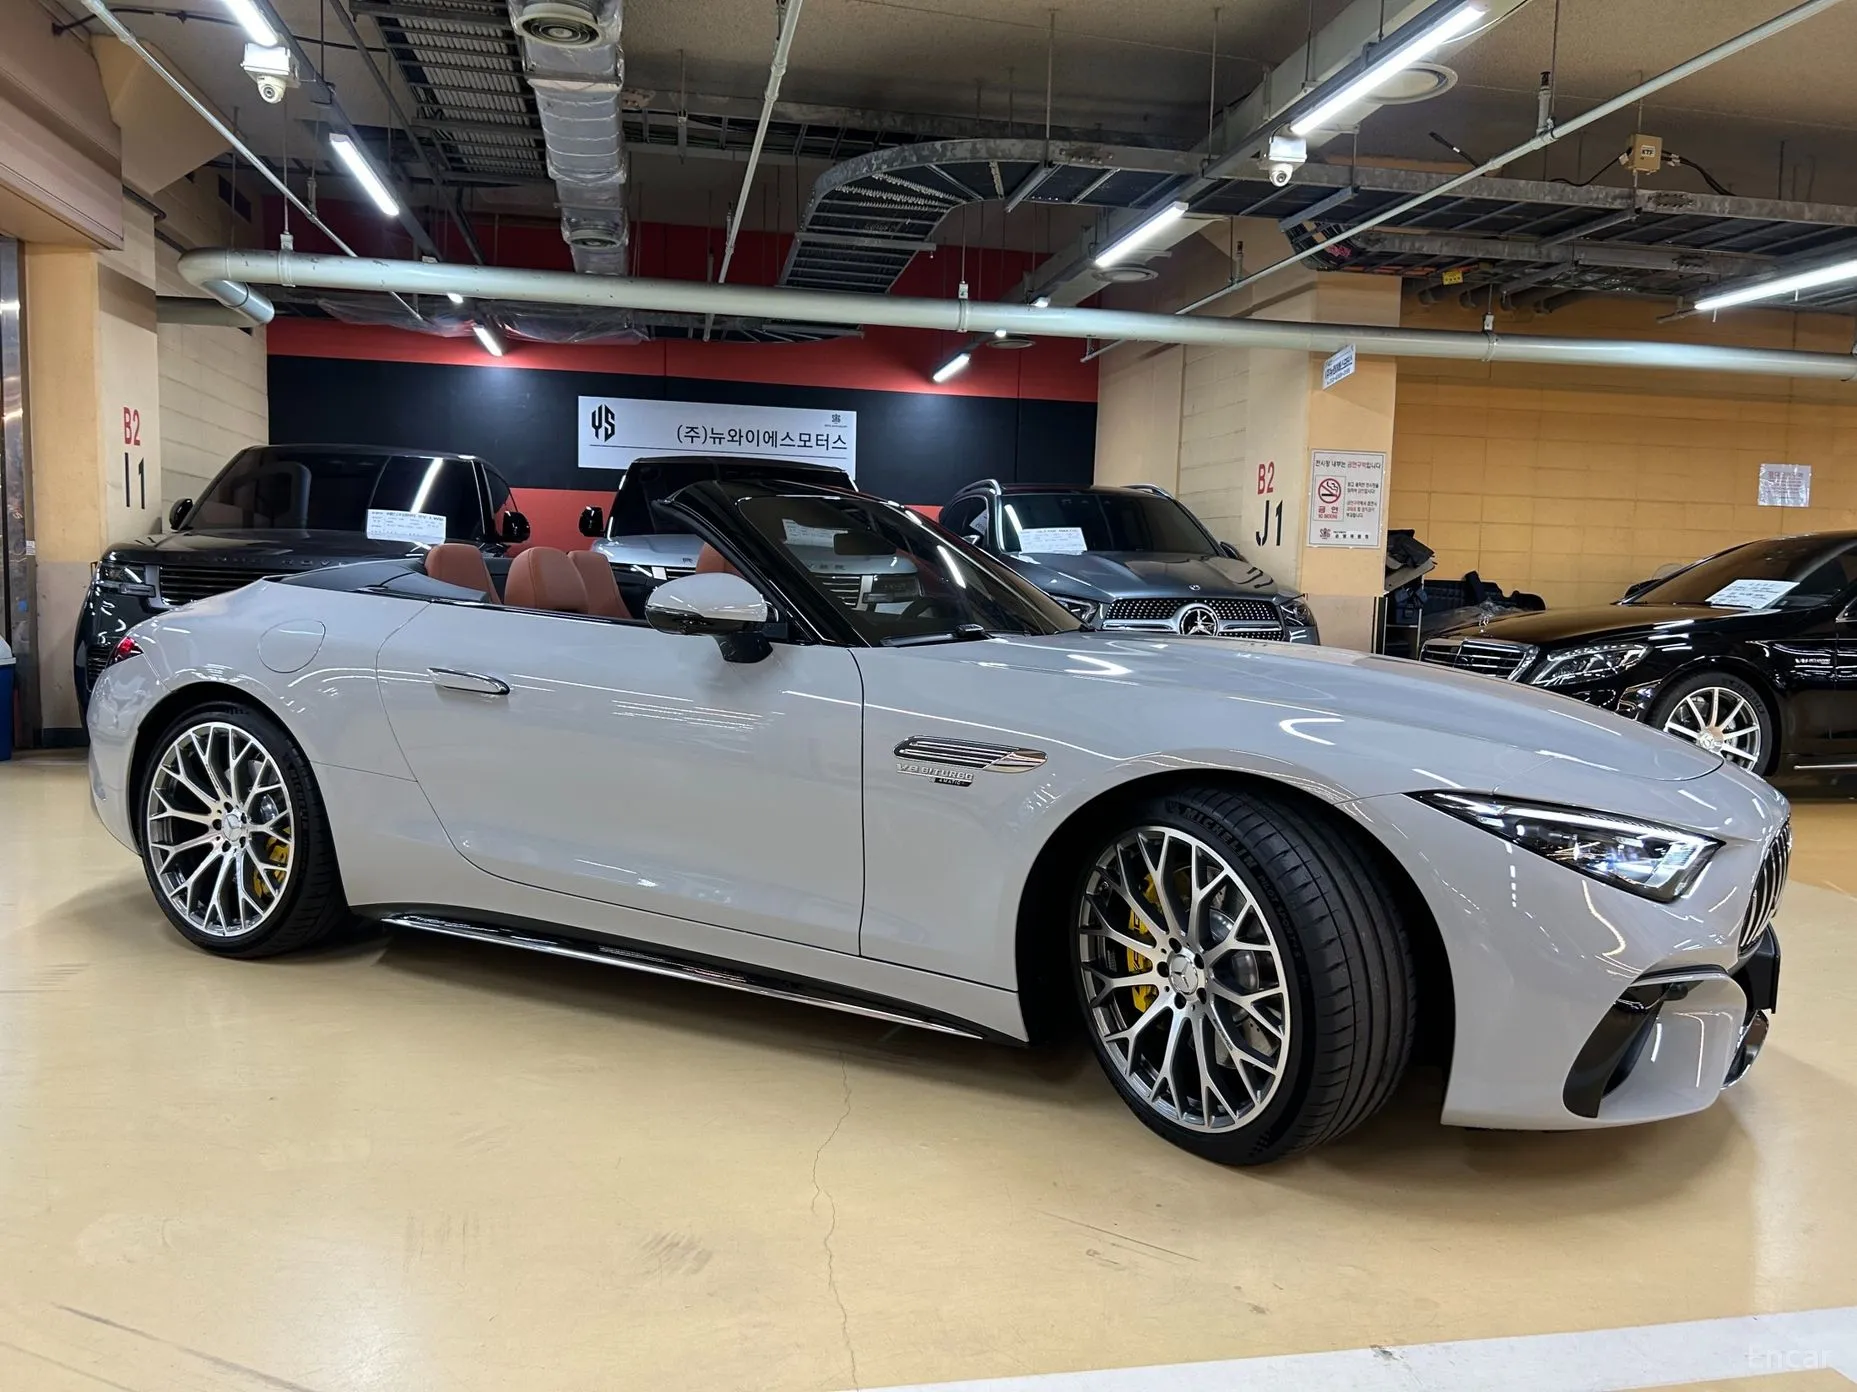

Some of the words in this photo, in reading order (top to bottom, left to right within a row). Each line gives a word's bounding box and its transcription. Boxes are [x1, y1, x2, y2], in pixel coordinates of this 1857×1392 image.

[123, 406, 141, 446] B2
[592, 404, 615, 442] YS
[676, 424, 847, 450] (주)뉴와이에스모터스
[1257, 461, 1275, 495] B2
[1255, 500, 1283, 546] J1
[896, 763, 919, 771] V8
[921, 766, 974, 780] BITURBO
[1182, 806, 1259, 869] MICHELIN
